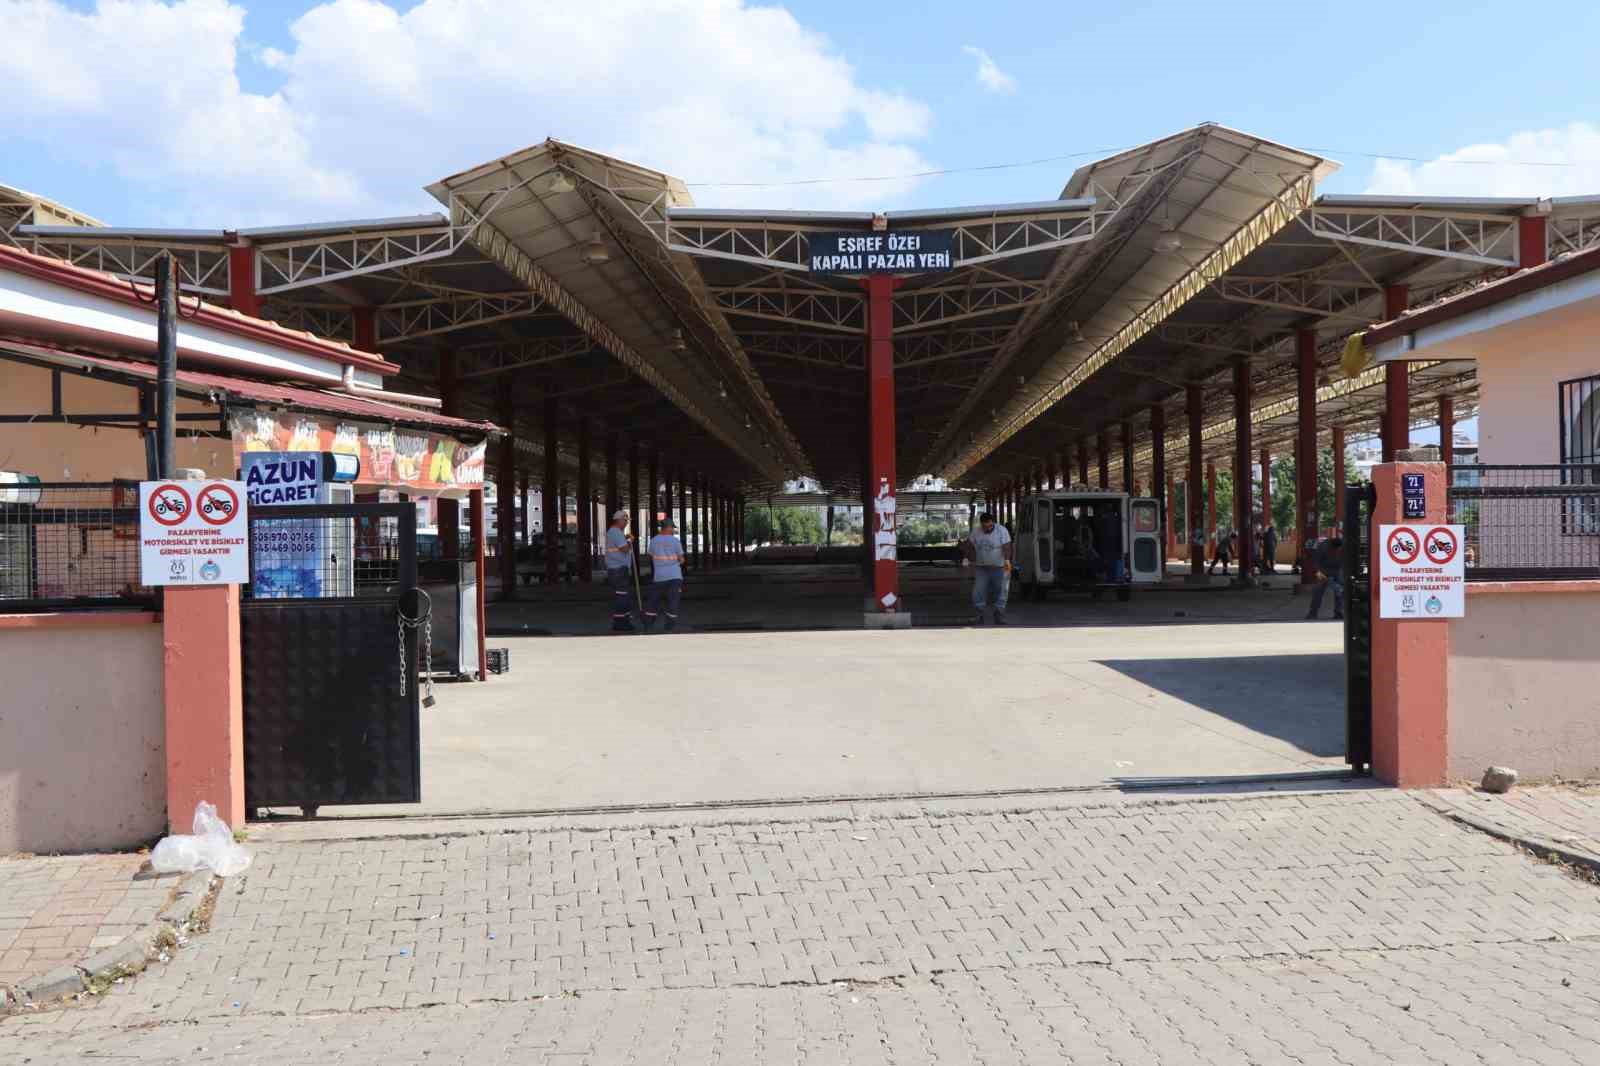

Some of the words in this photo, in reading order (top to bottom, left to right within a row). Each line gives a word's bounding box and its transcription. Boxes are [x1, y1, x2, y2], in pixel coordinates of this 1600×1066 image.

[838, 237, 882, 253] EŞREF
[813, 255, 862, 270] KAPALI
[867, 254, 915, 269] PAZAR
[919, 250, 950, 267] YERİ
[247, 459, 316, 486] AZUN
[1408, 477, 1418, 487] 71
[1407, 499, 1418, 510] 71
